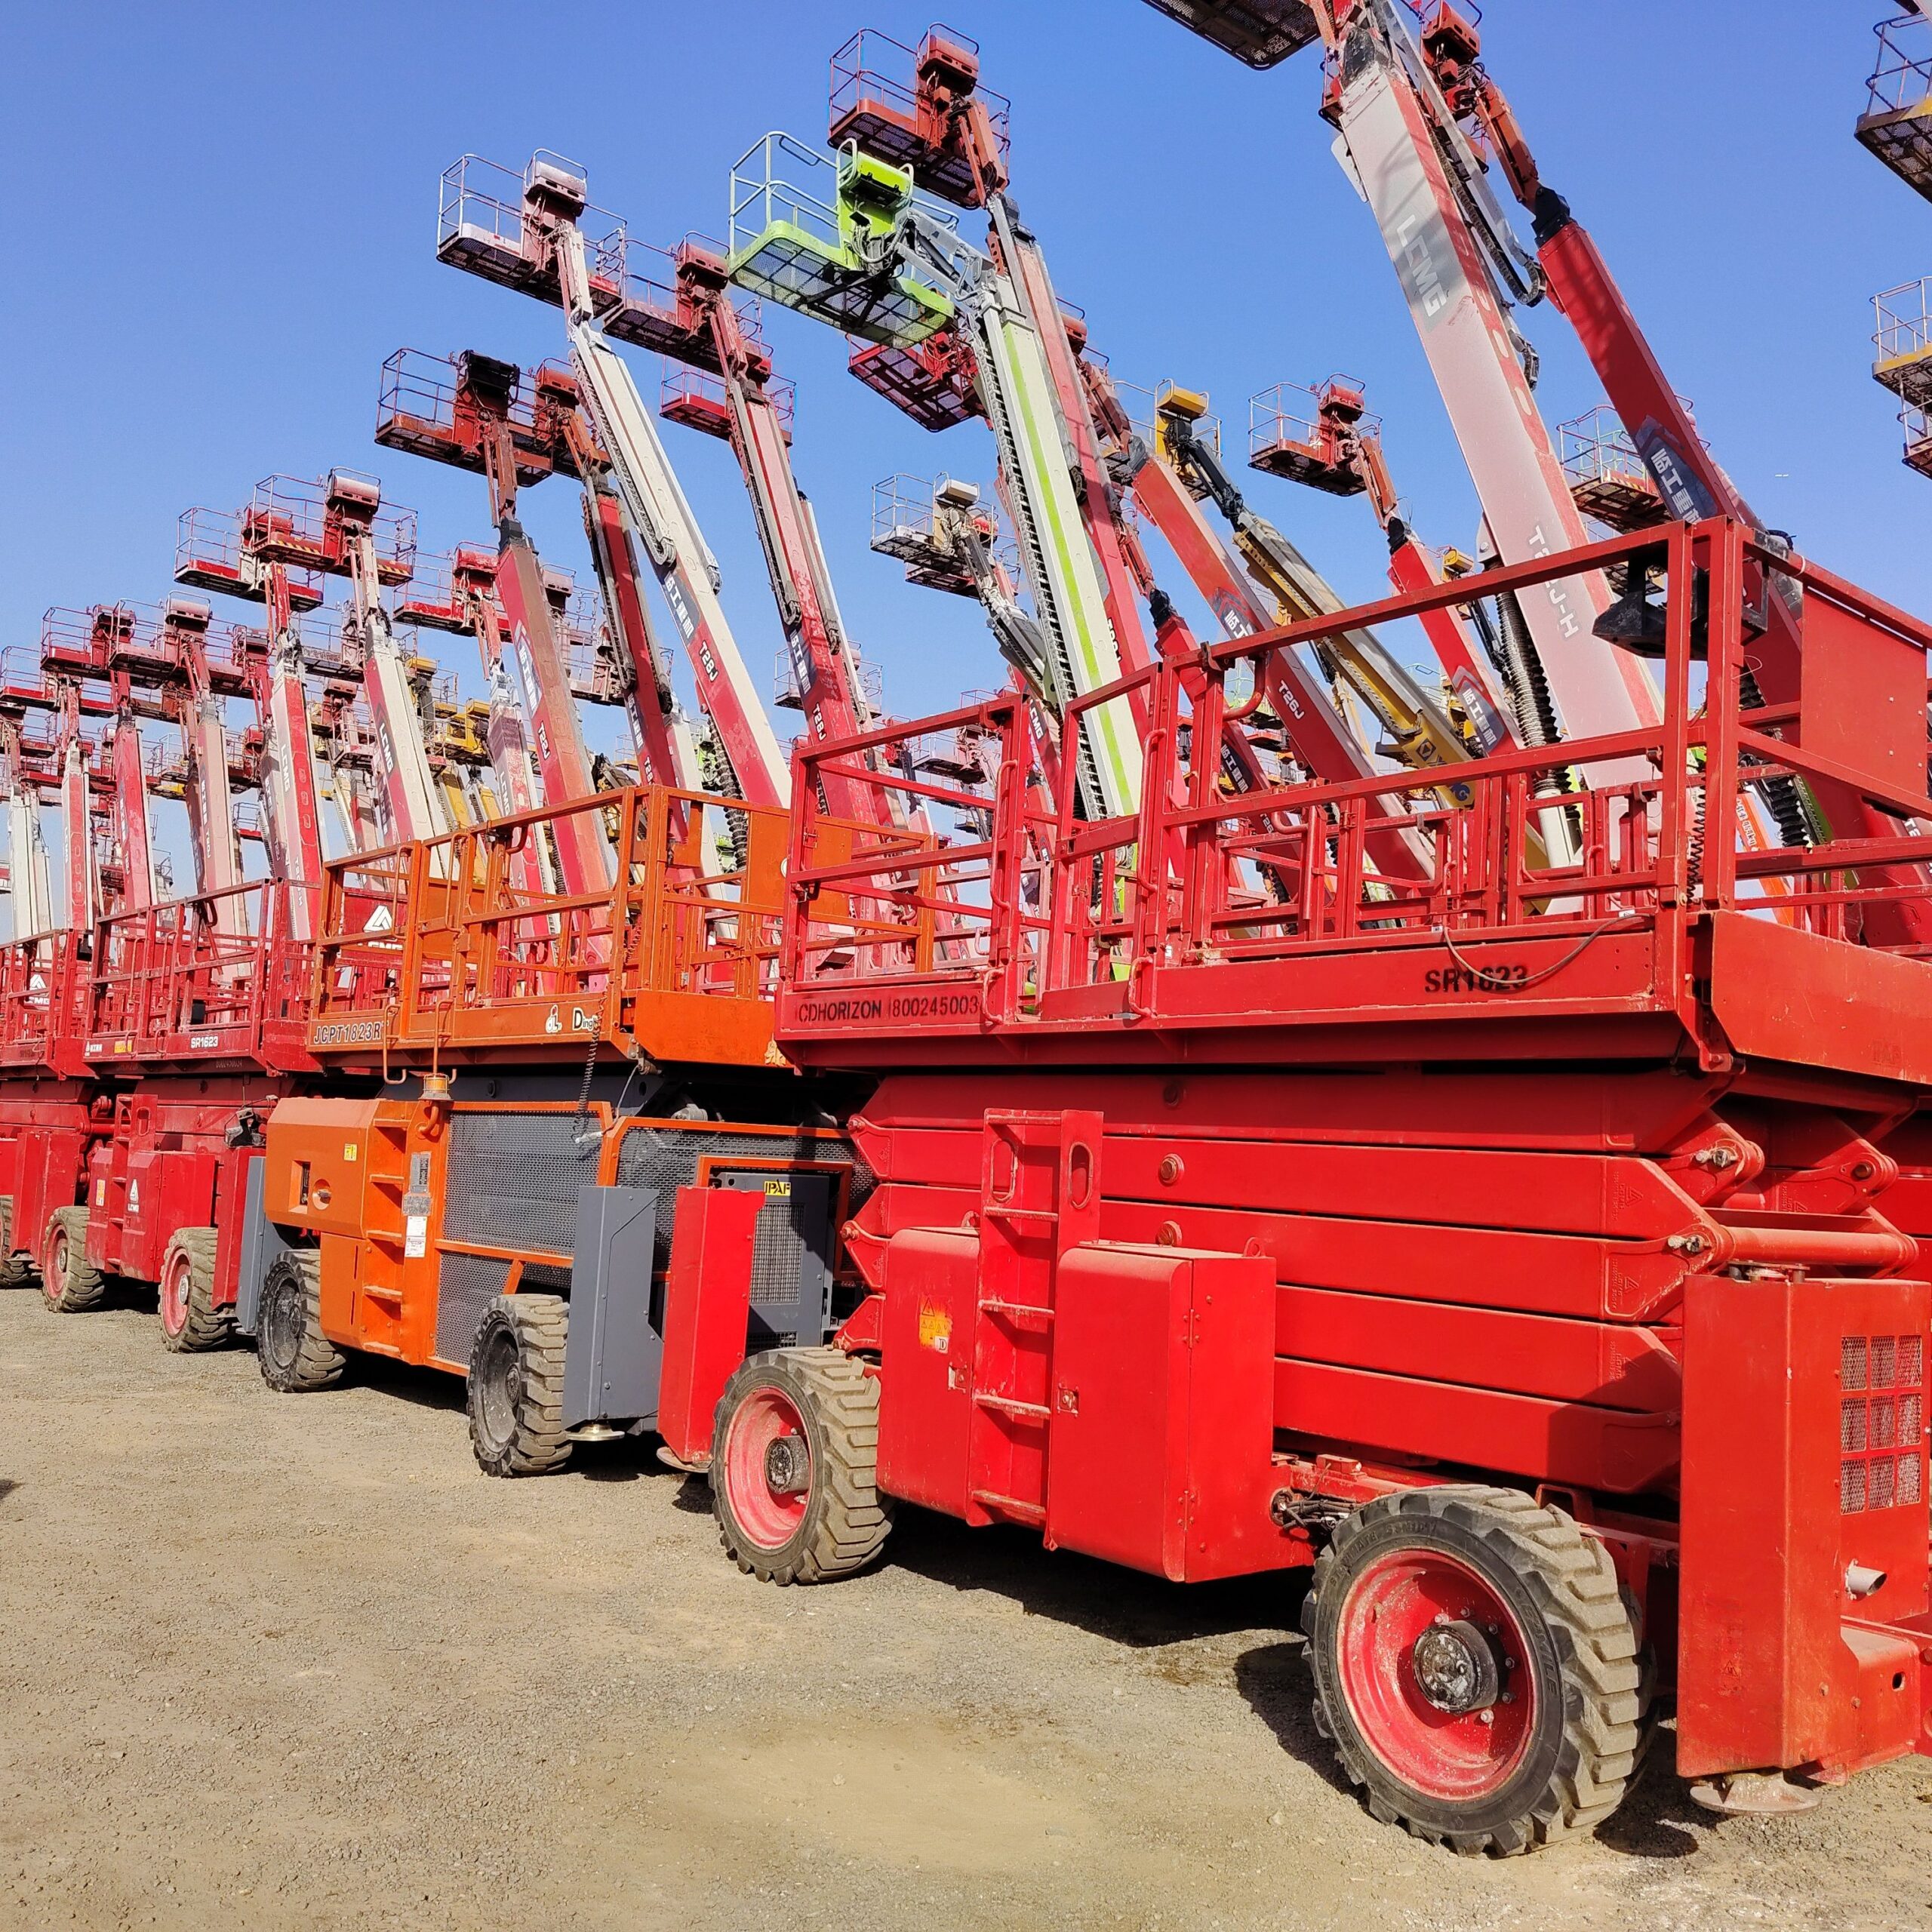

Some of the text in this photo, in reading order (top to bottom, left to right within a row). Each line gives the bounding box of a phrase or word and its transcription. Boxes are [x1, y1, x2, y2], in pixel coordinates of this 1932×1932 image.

[1529, 525, 1578, 638] T2J-H
[1224, 610, 1249, 640] 临工
[698, 640, 718, 682] T28J
[1278, 679, 1305, 721] T26J
[1463, 688, 1497, 746] 临工重机
[537, 721, 551, 761] T22J
[812, 703, 827, 741] T28J
[644, 755, 655, 785] T28
[1221, 744, 1249, 793] 临工重机
[1425, 965, 1527, 992] SR1623
[798, 999, 881, 1023] CDHORIZON
[190, 1035, 218, 1048] SR1623
[765, 1179, 790, 1195] IPAF
